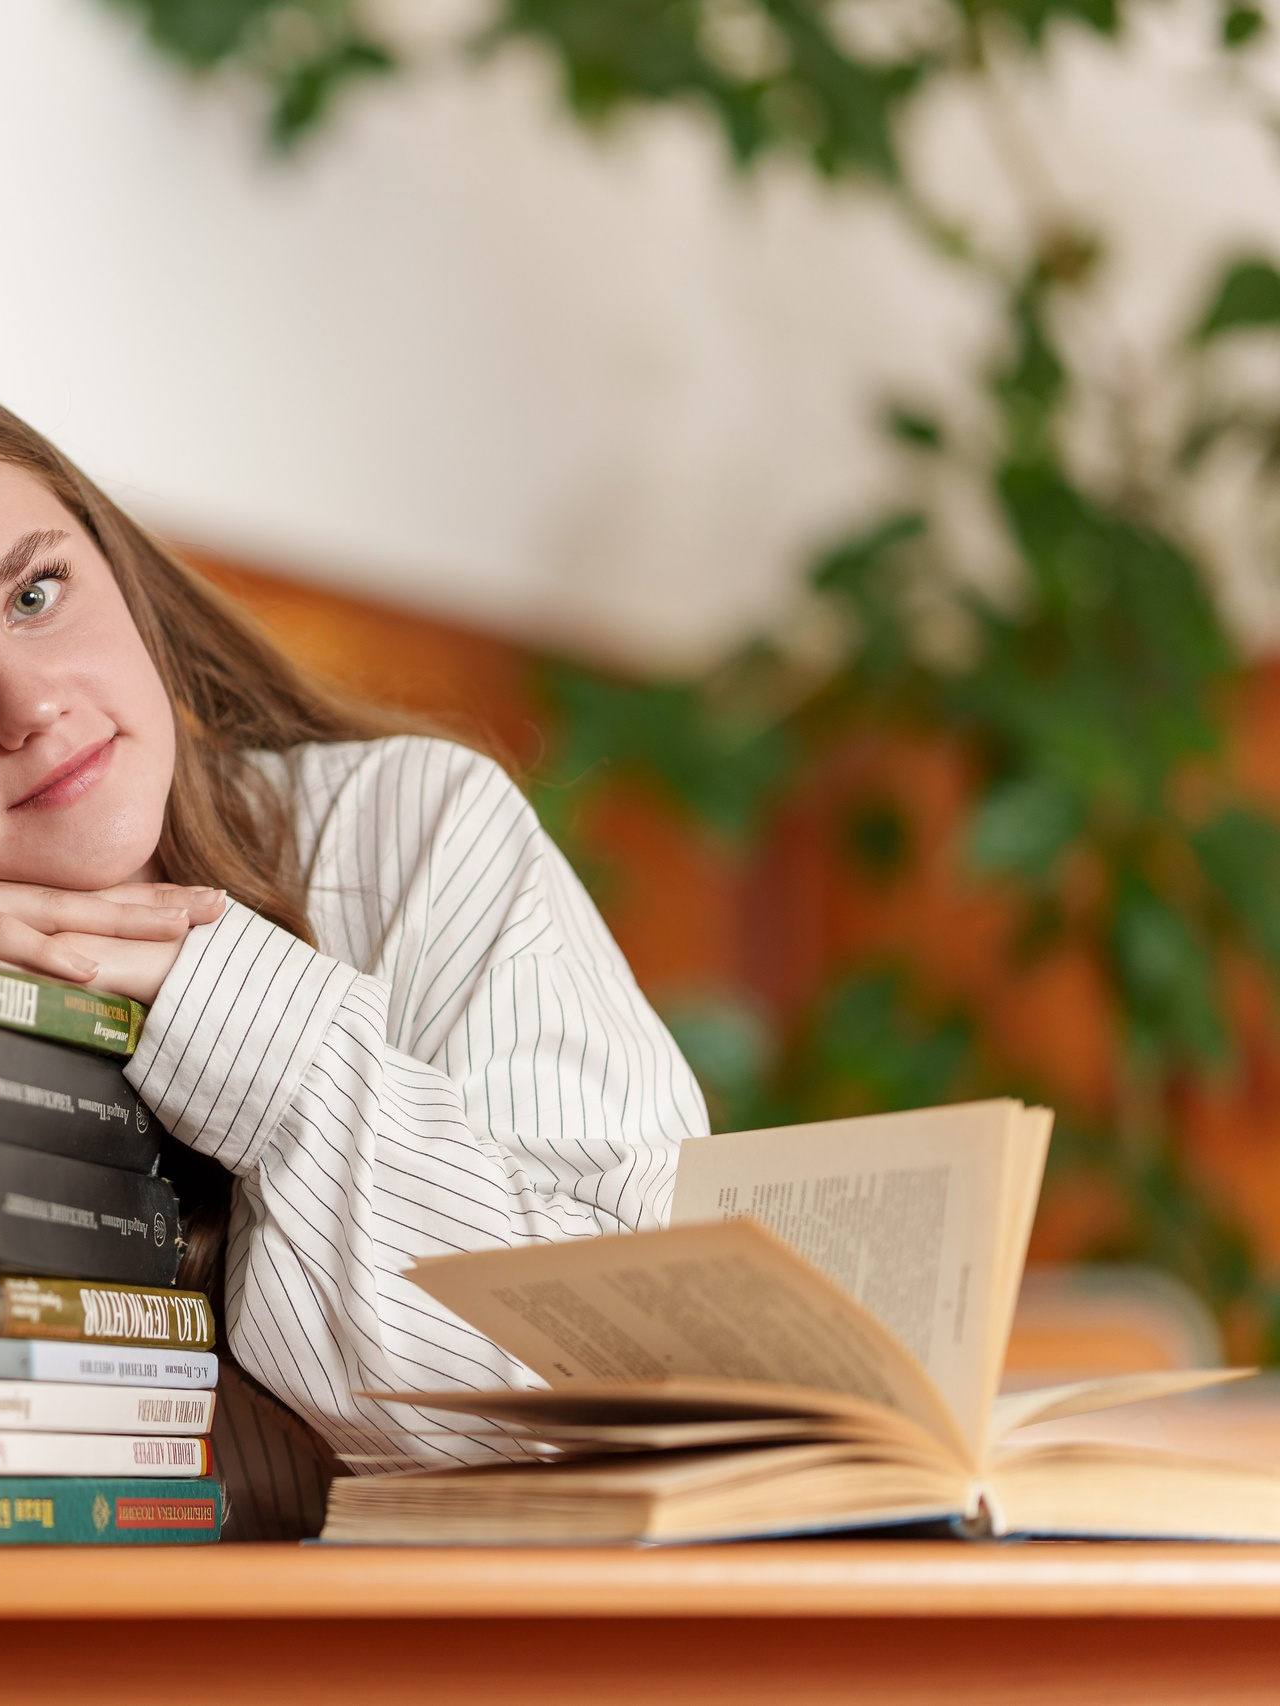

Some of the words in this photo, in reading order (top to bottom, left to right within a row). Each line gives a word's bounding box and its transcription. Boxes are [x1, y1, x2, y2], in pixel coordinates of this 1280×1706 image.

[79, 1288, 171, 1340] ЛЕРМОНТОВ
[119, 1362, 158, 1379] ЕВГЕНИЙ
[165, 1363, 192, 1378] Пушкин
[138, 1397, 173, 1423] ЦВЕТАЕВА
[174, 1400, 206, 1423] МАРИНА
[133, 1439, 165, 1465] АНДРЕЕВ
[166, 1439, 196, 1465] ЛЕОНИД
[119, 1505, 155, 1521] ПОЭЗИИ
[157, 1505, 213, 1521] БИБЛИОТЕКА
